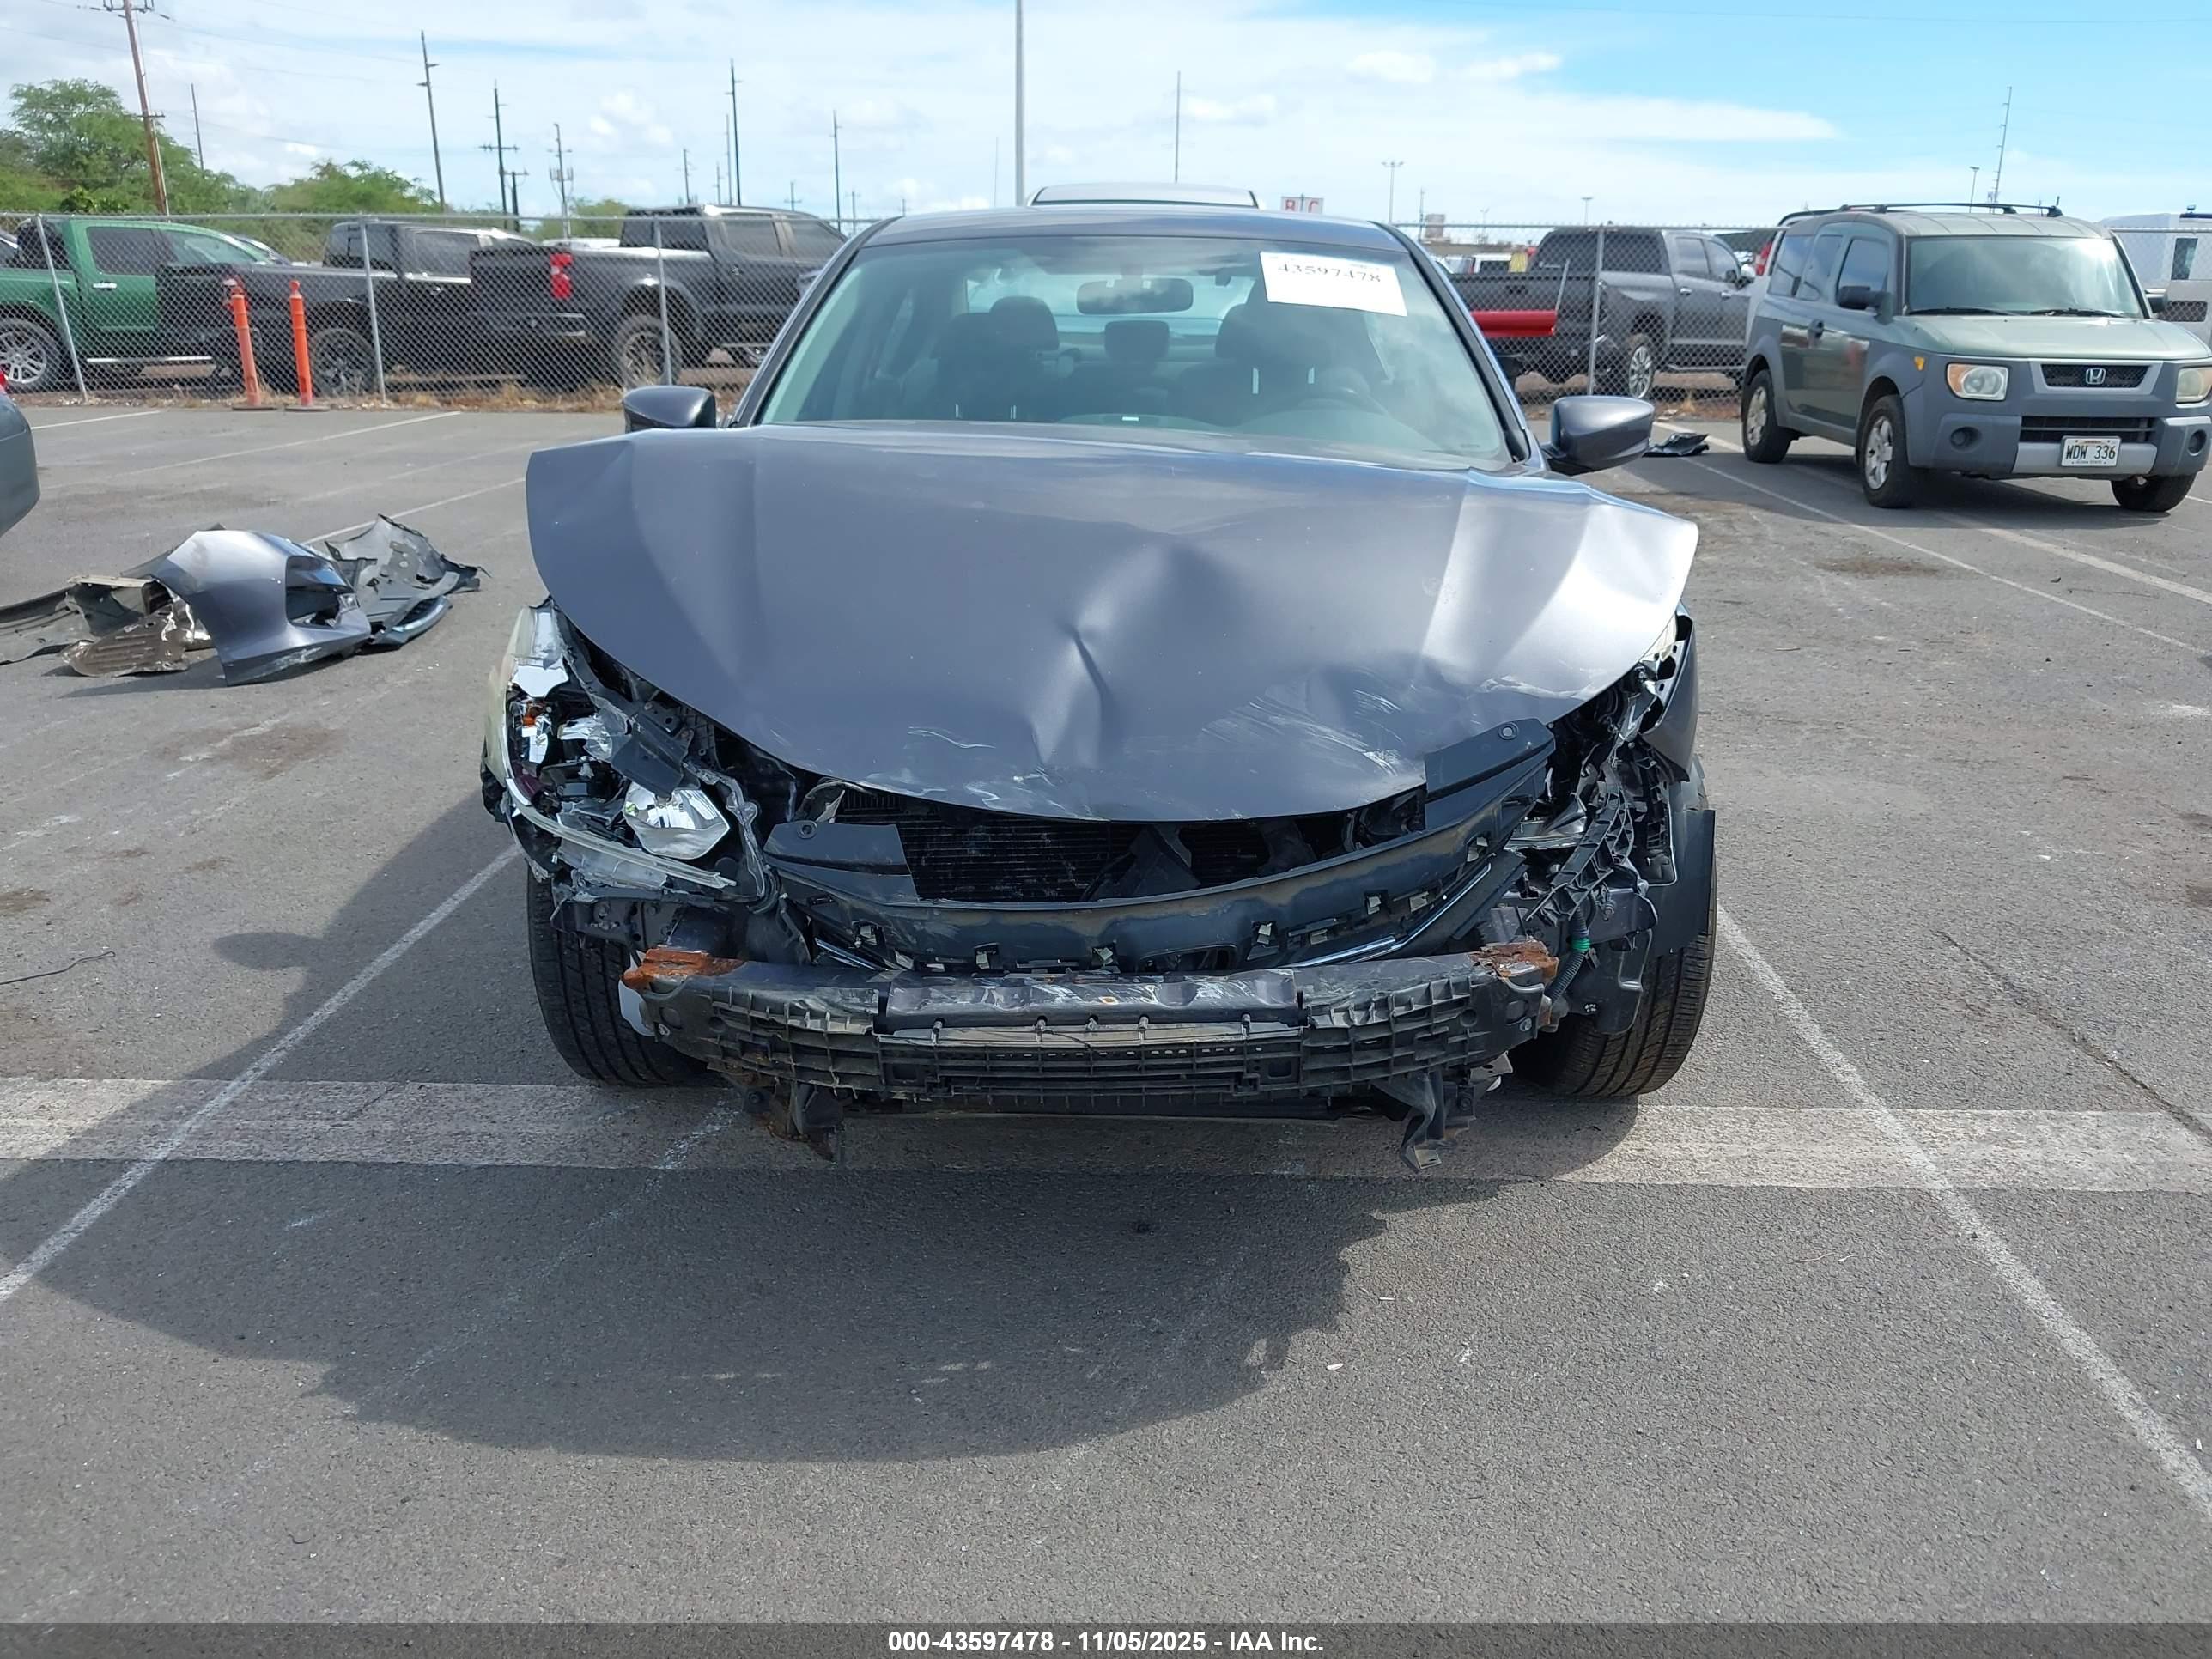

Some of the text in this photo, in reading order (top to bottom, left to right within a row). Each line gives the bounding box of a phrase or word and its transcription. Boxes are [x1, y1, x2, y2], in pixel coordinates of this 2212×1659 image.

[1278, 262, 1381, 283] 43597478
[2065, 445, 2116, 459] WDW 336
